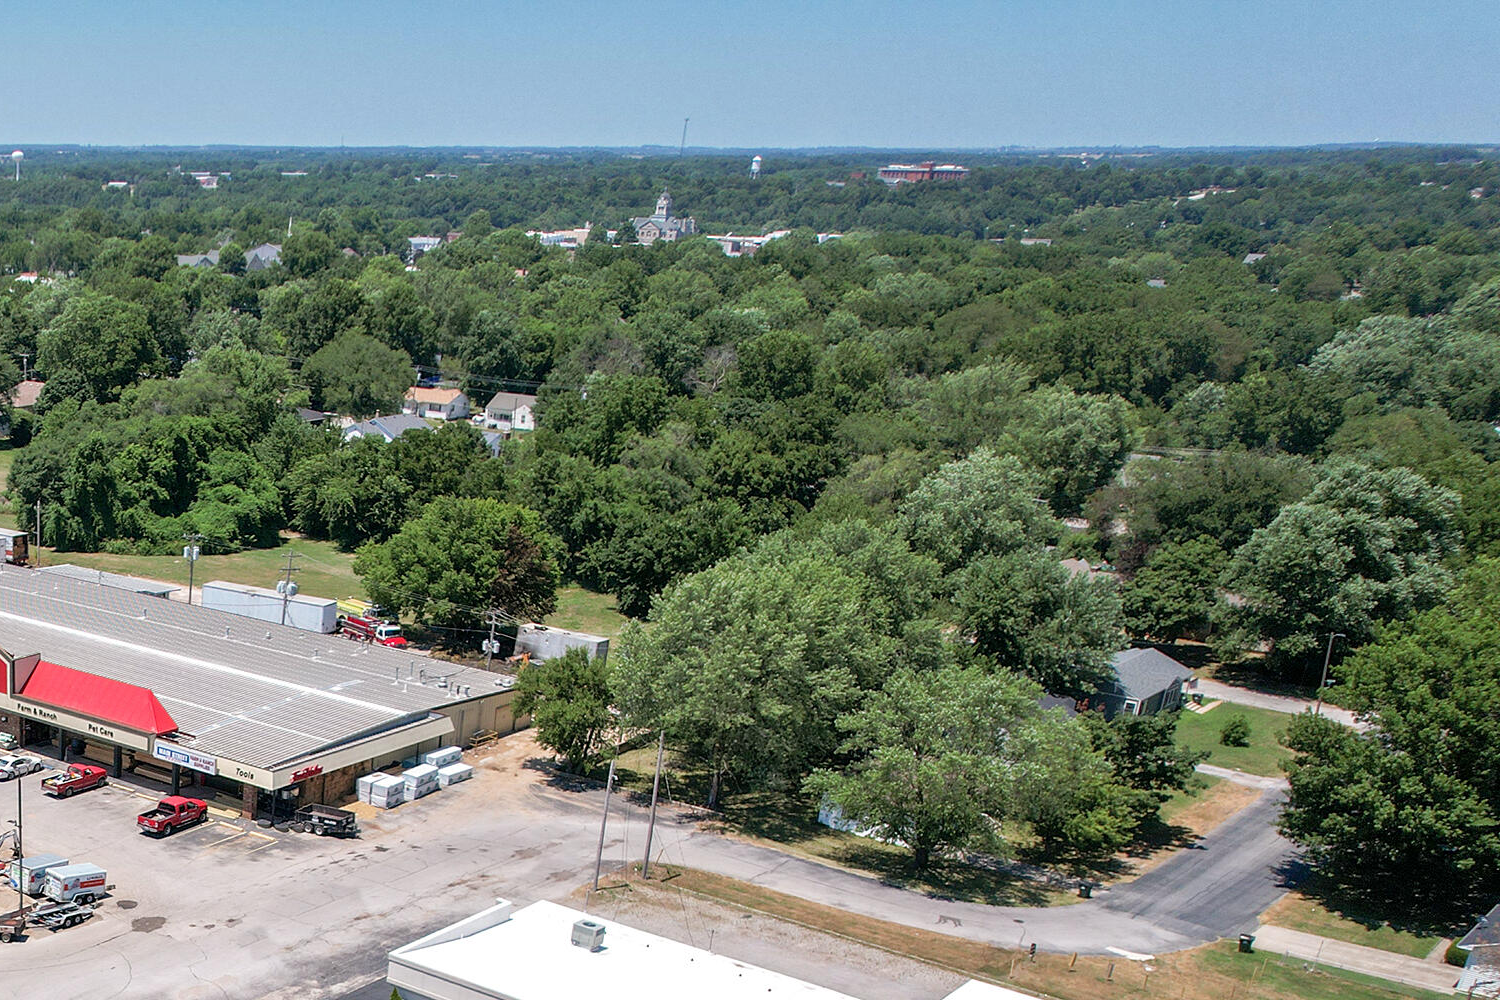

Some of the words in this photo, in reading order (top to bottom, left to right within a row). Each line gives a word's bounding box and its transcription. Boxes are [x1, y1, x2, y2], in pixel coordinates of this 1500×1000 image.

[17, 703, 31, 713] Farm
[38, 709, 57, 720] Ranch
[88, 724, 98, 733] Pet
[100, 727, 114, 738] Care
[236, 767, 254, 780] Tools
